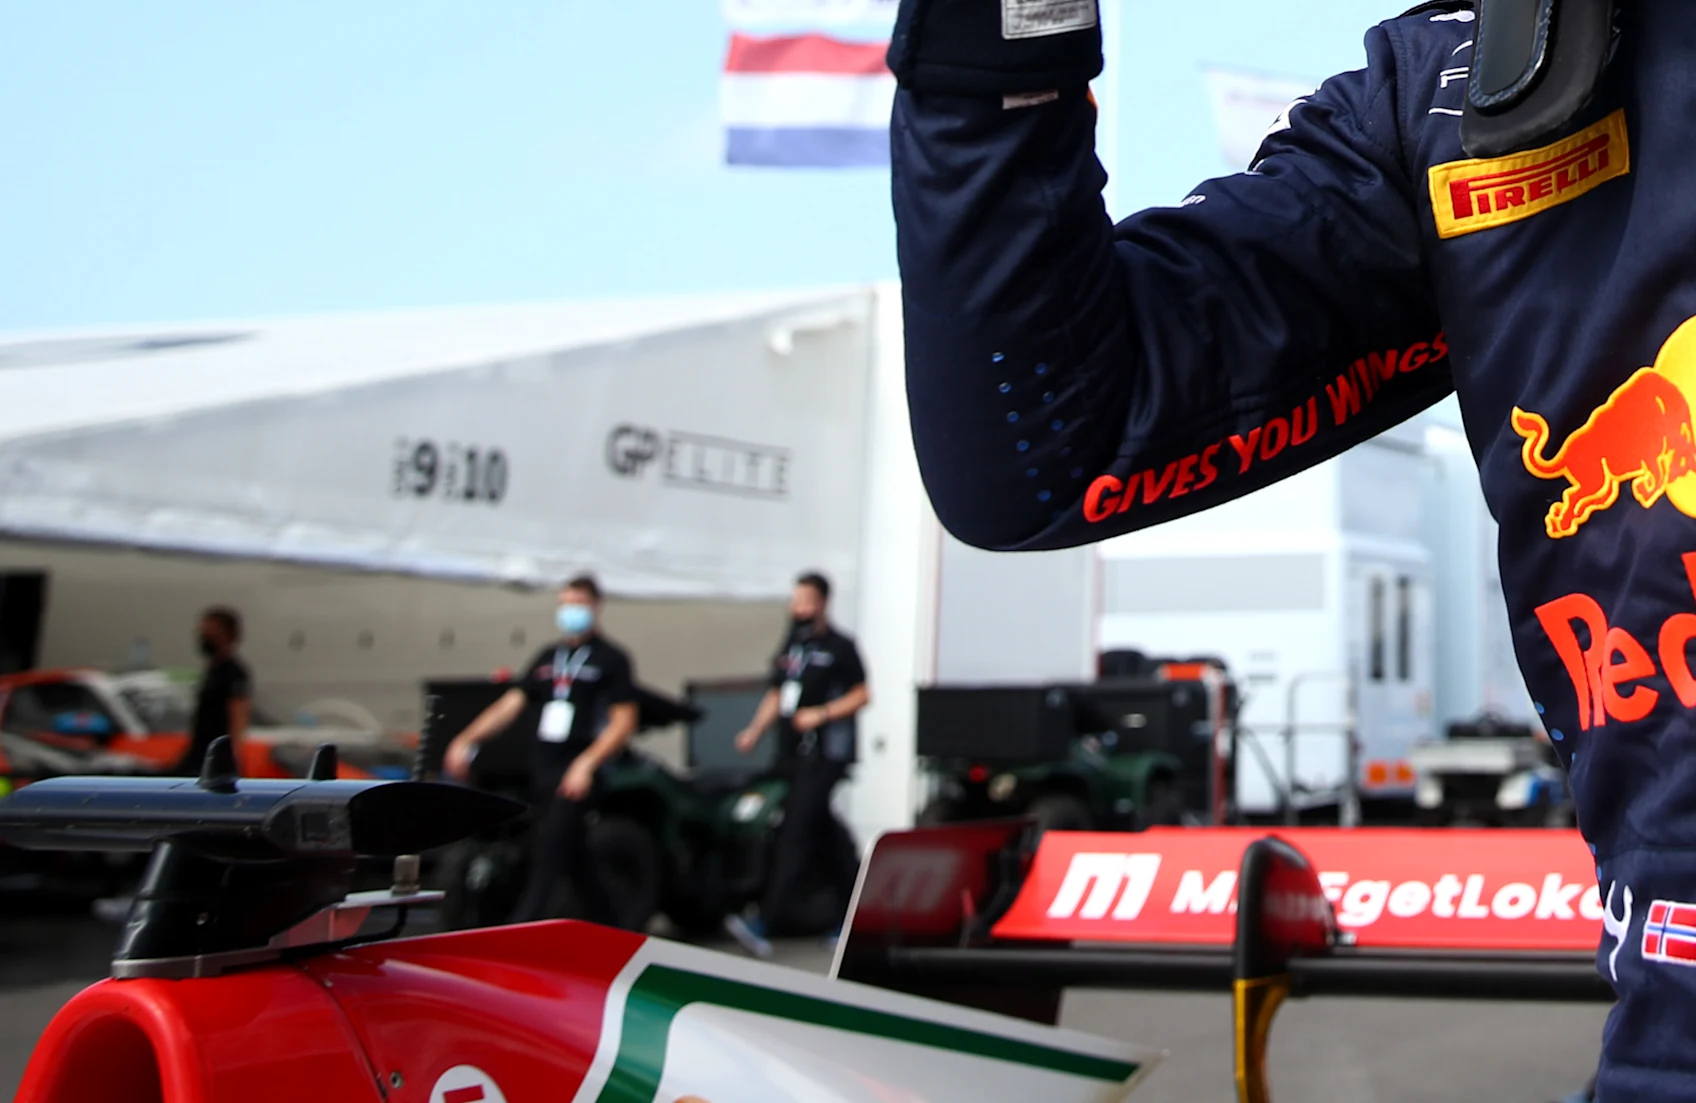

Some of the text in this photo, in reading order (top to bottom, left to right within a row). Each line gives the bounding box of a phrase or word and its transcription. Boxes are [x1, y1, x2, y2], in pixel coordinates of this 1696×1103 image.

[1449, 133, 1610, 220] PIRELLI
[1082, 330, 1449, 523] GIVES YOU WINGS
